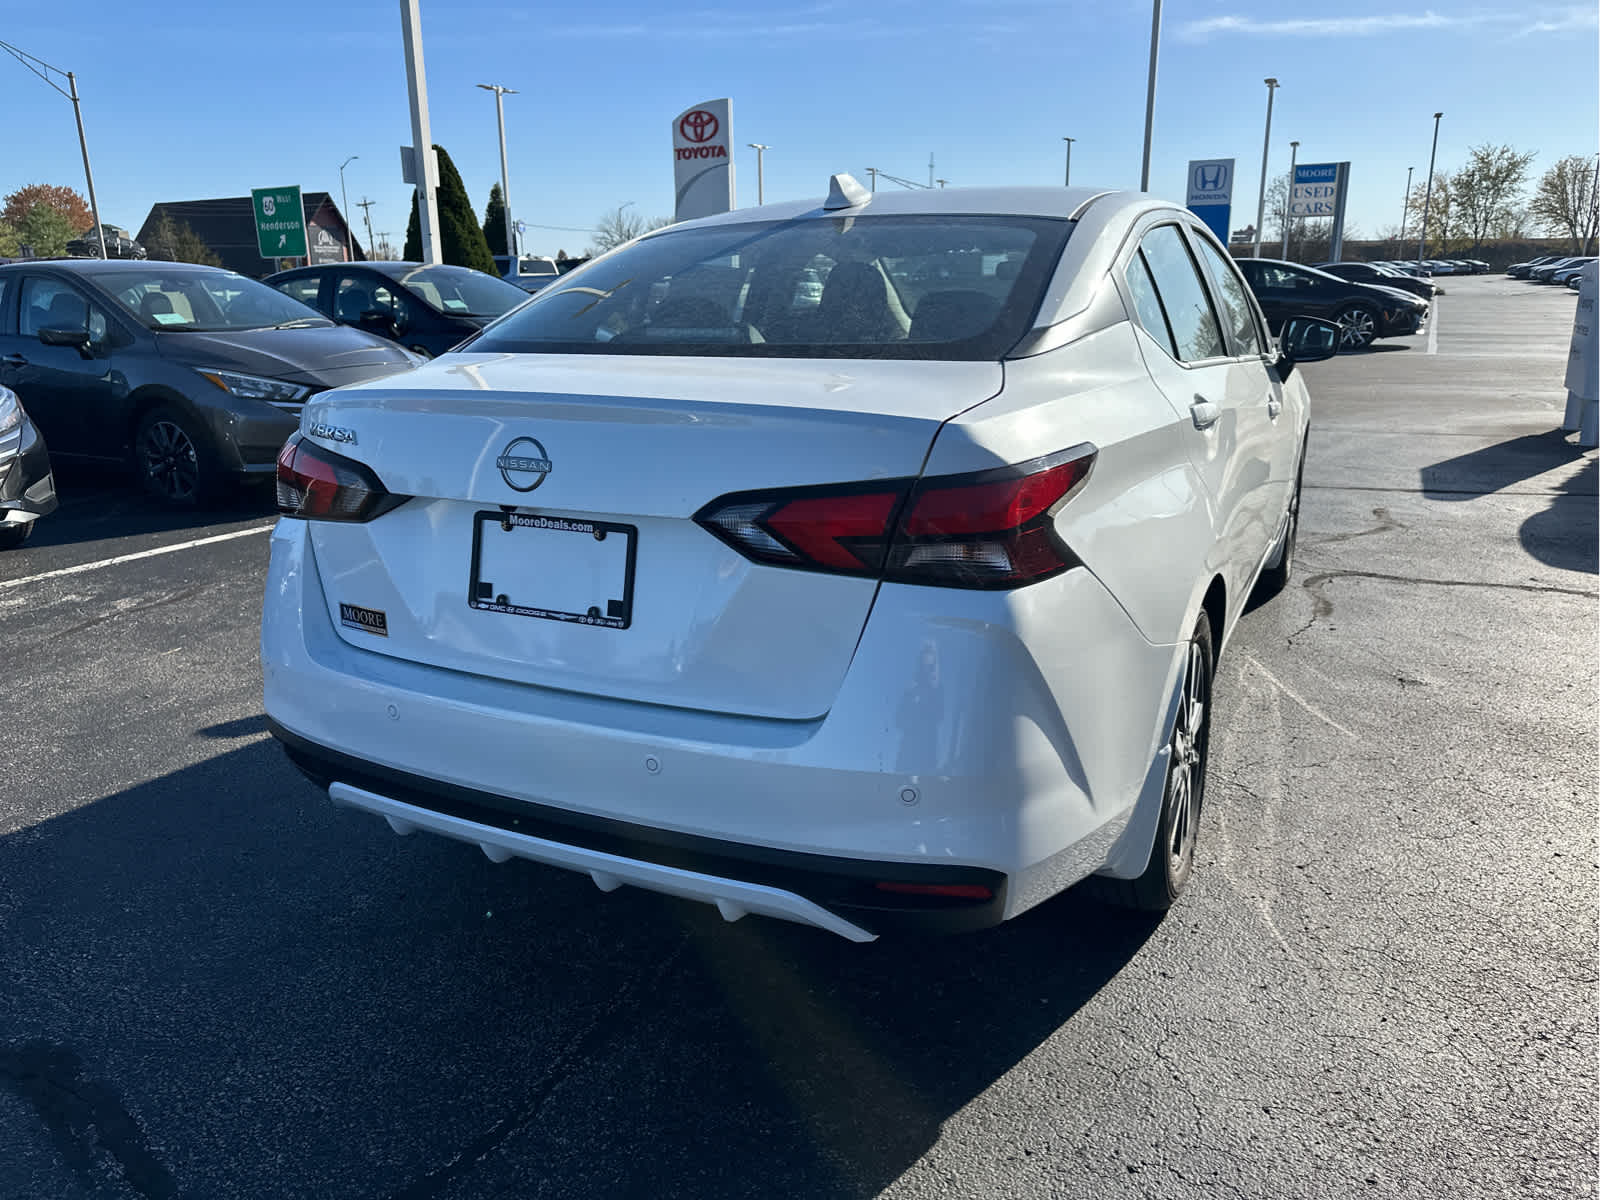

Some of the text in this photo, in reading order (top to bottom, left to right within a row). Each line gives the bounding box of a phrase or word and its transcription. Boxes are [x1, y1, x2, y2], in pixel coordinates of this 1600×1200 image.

[674, 145, 727, 160] TOYOTA
[1296, 168, 1335, 177] MOORE
[1191, 193, 1228, 201] HONDA
[1294, 185, 1334, 200] USED
[1291, 200, 1333, 215] CARS
[261, 220, 300, 232] Henderson
[309, 423, 359, 446] VERSA
[497, 456, 552, 473] NISSAN
[509, 514, 594, 533] MooreDeals.com
[343, 606, 385, 627] MOORE
[515, 607, 547, 616] DODGE
